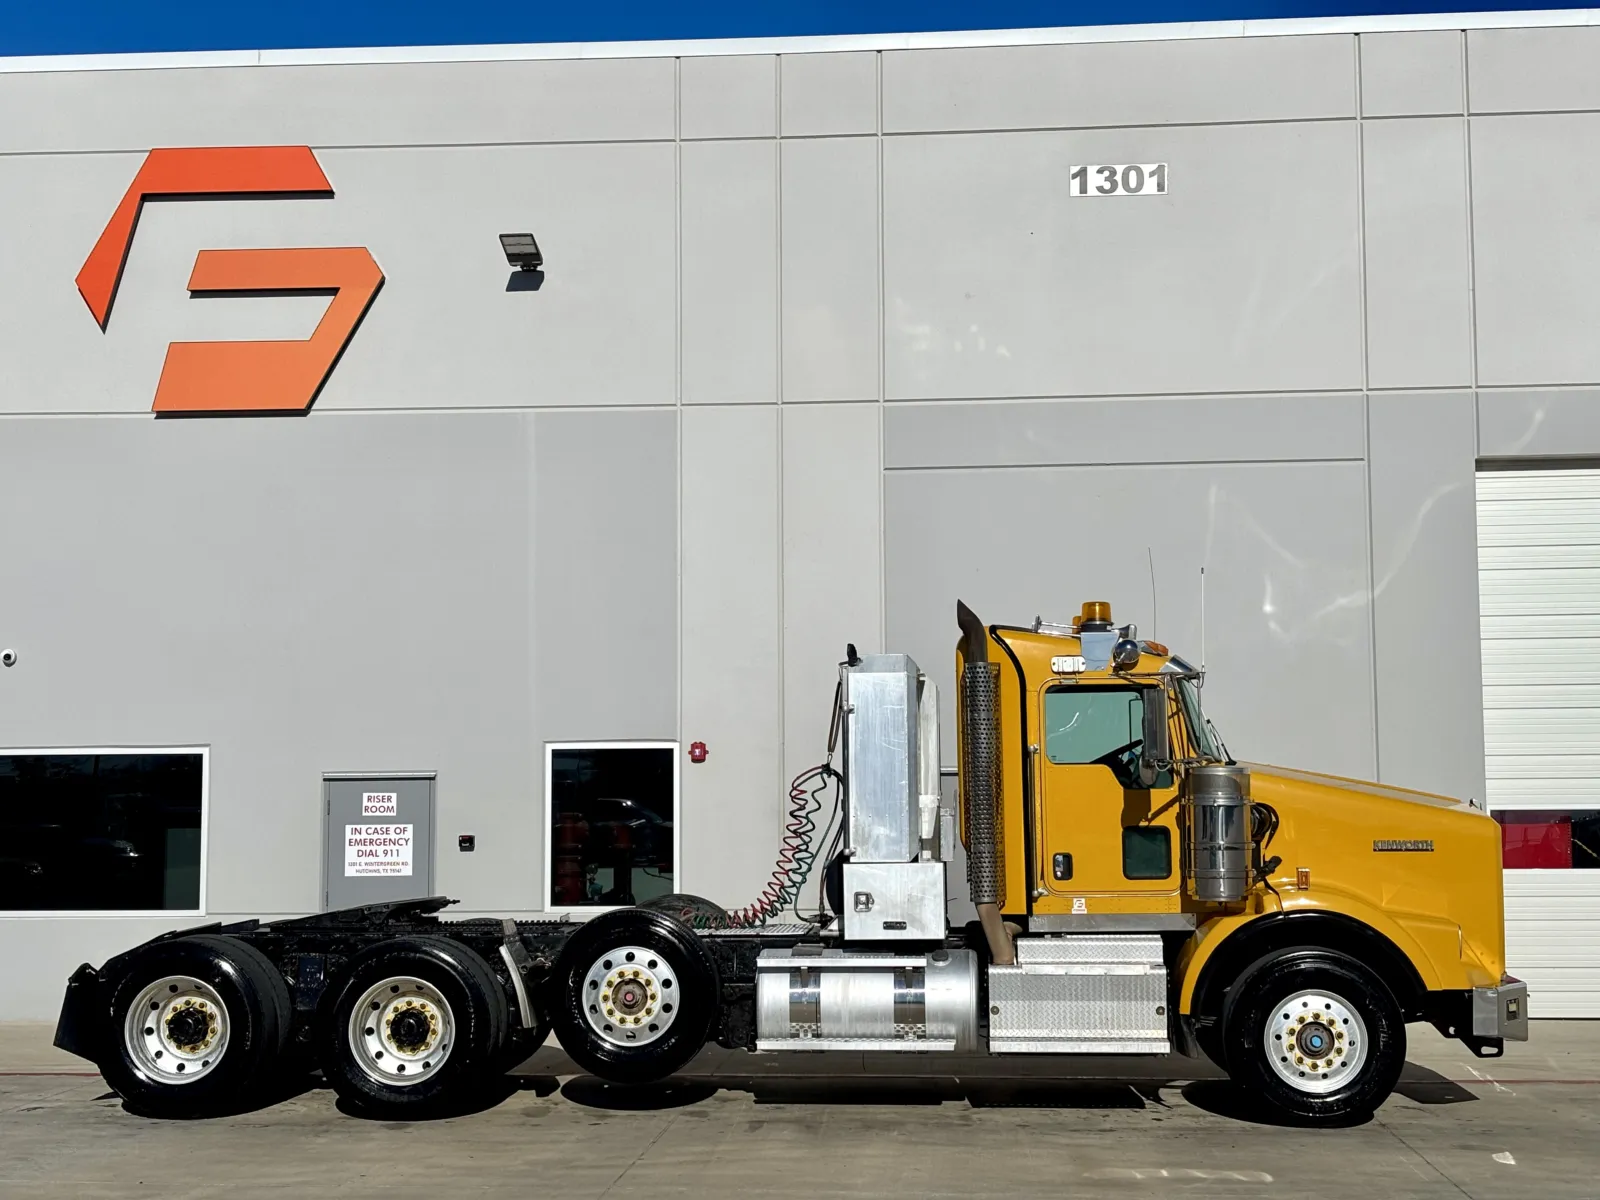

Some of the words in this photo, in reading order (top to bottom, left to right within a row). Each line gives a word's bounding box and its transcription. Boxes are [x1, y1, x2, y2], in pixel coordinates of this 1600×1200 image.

[1071, 165, 1166, 195] 1301
[367, 795, 393, 803] RISER
[364, 805, 395, 814] ROOM
[351, 827, 362, 835] IN
[365, 827, 391, 835] CASE
[394, 826, 408, 835] OF
[348, 838, 410, 846] EMERGENCY
[1373, 840, 1434, 851] KENWORTH
[357, 849, 380, 857] DIAL
[383, 849, 400, 857] 911
